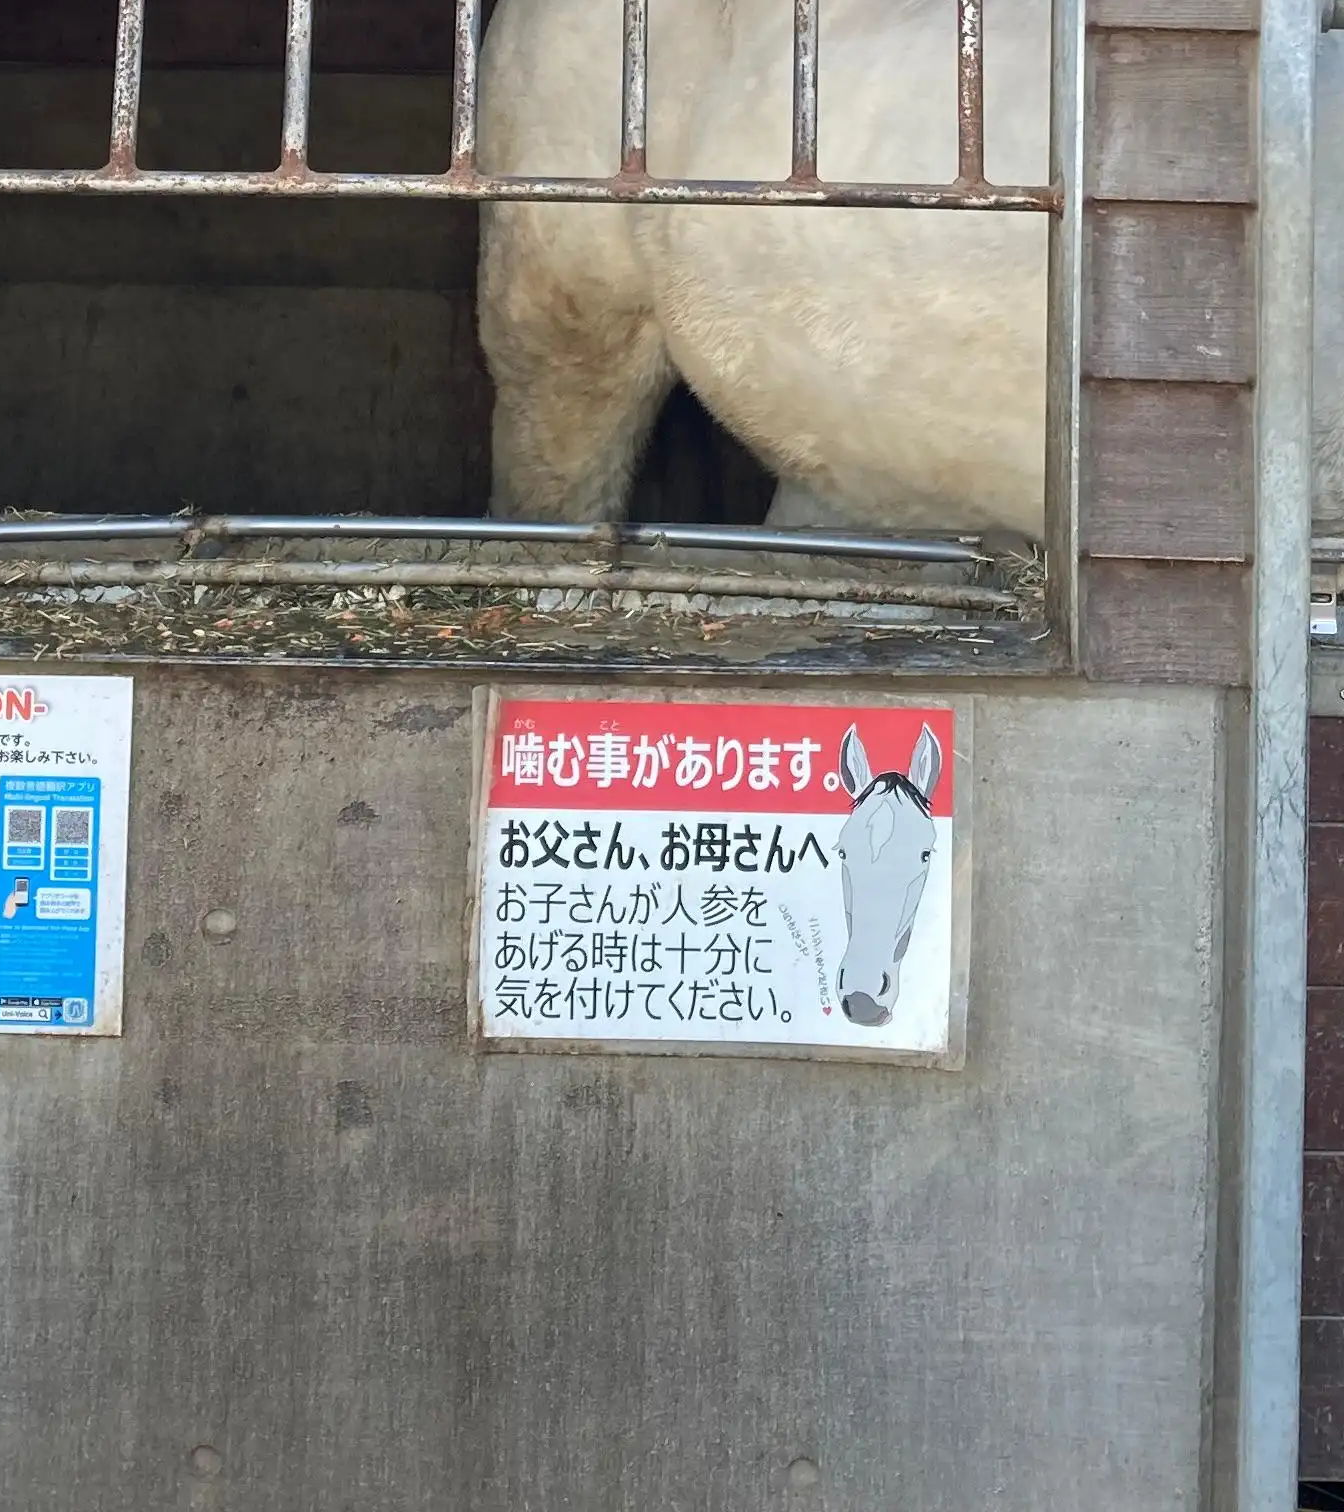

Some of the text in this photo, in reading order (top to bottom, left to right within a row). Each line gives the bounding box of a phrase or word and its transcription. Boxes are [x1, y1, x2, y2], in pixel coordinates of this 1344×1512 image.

[501, 733, 841, 792] 噛む事があります。
[499, 819, 829, 874] お父さん、お母さんへ
[496, 883, 769, 928] お子さんが人参を
[494, 931, 773, 975] あげる時は十分に
[494, 976, 793, 1024] 気を付けてください。
